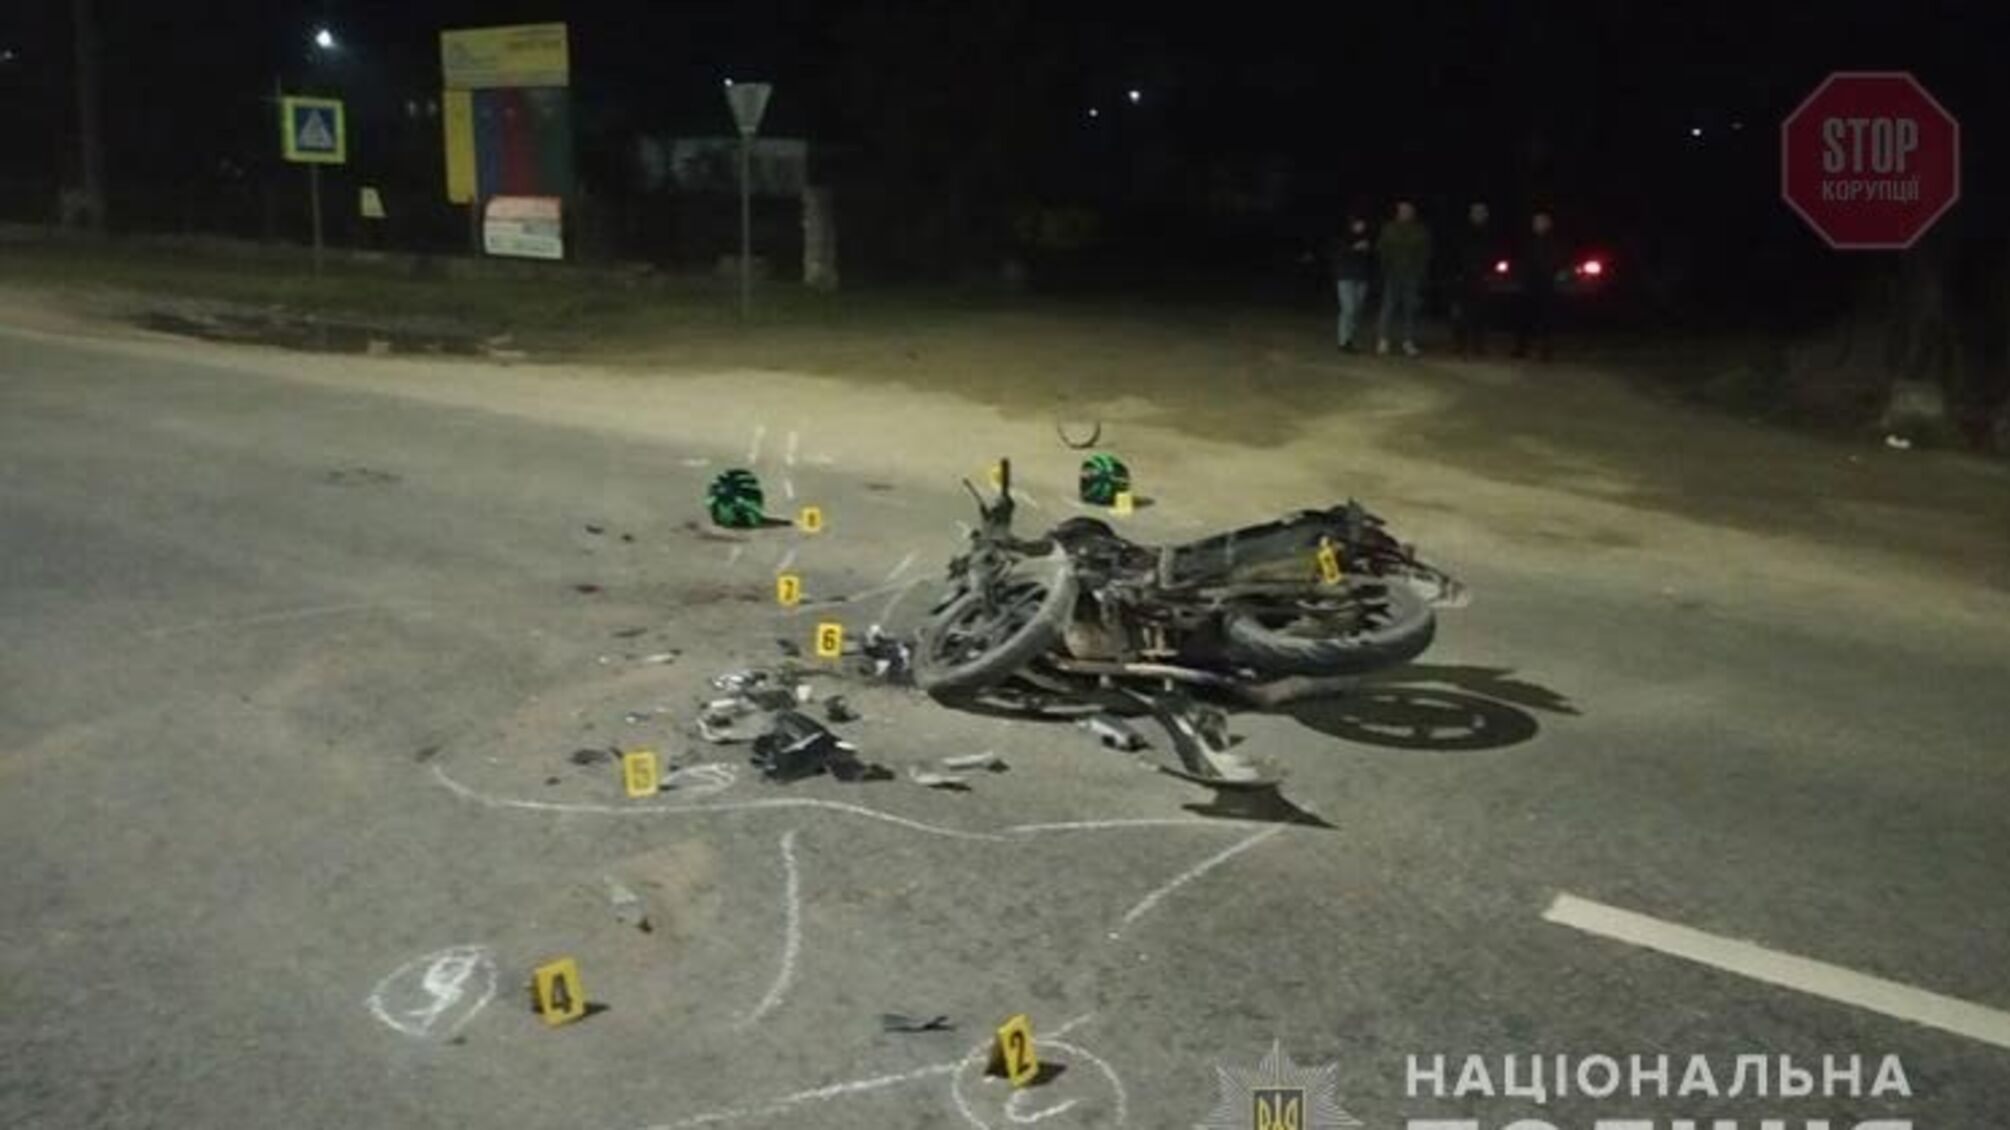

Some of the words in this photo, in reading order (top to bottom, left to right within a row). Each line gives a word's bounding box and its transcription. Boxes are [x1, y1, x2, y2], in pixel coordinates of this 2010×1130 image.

[822, 628, 836, 652] 6
[631, 758, 651, 790] 5
[550, 972, 572, 1014] 4
[1010, 1030, 1031, 1074] 2
